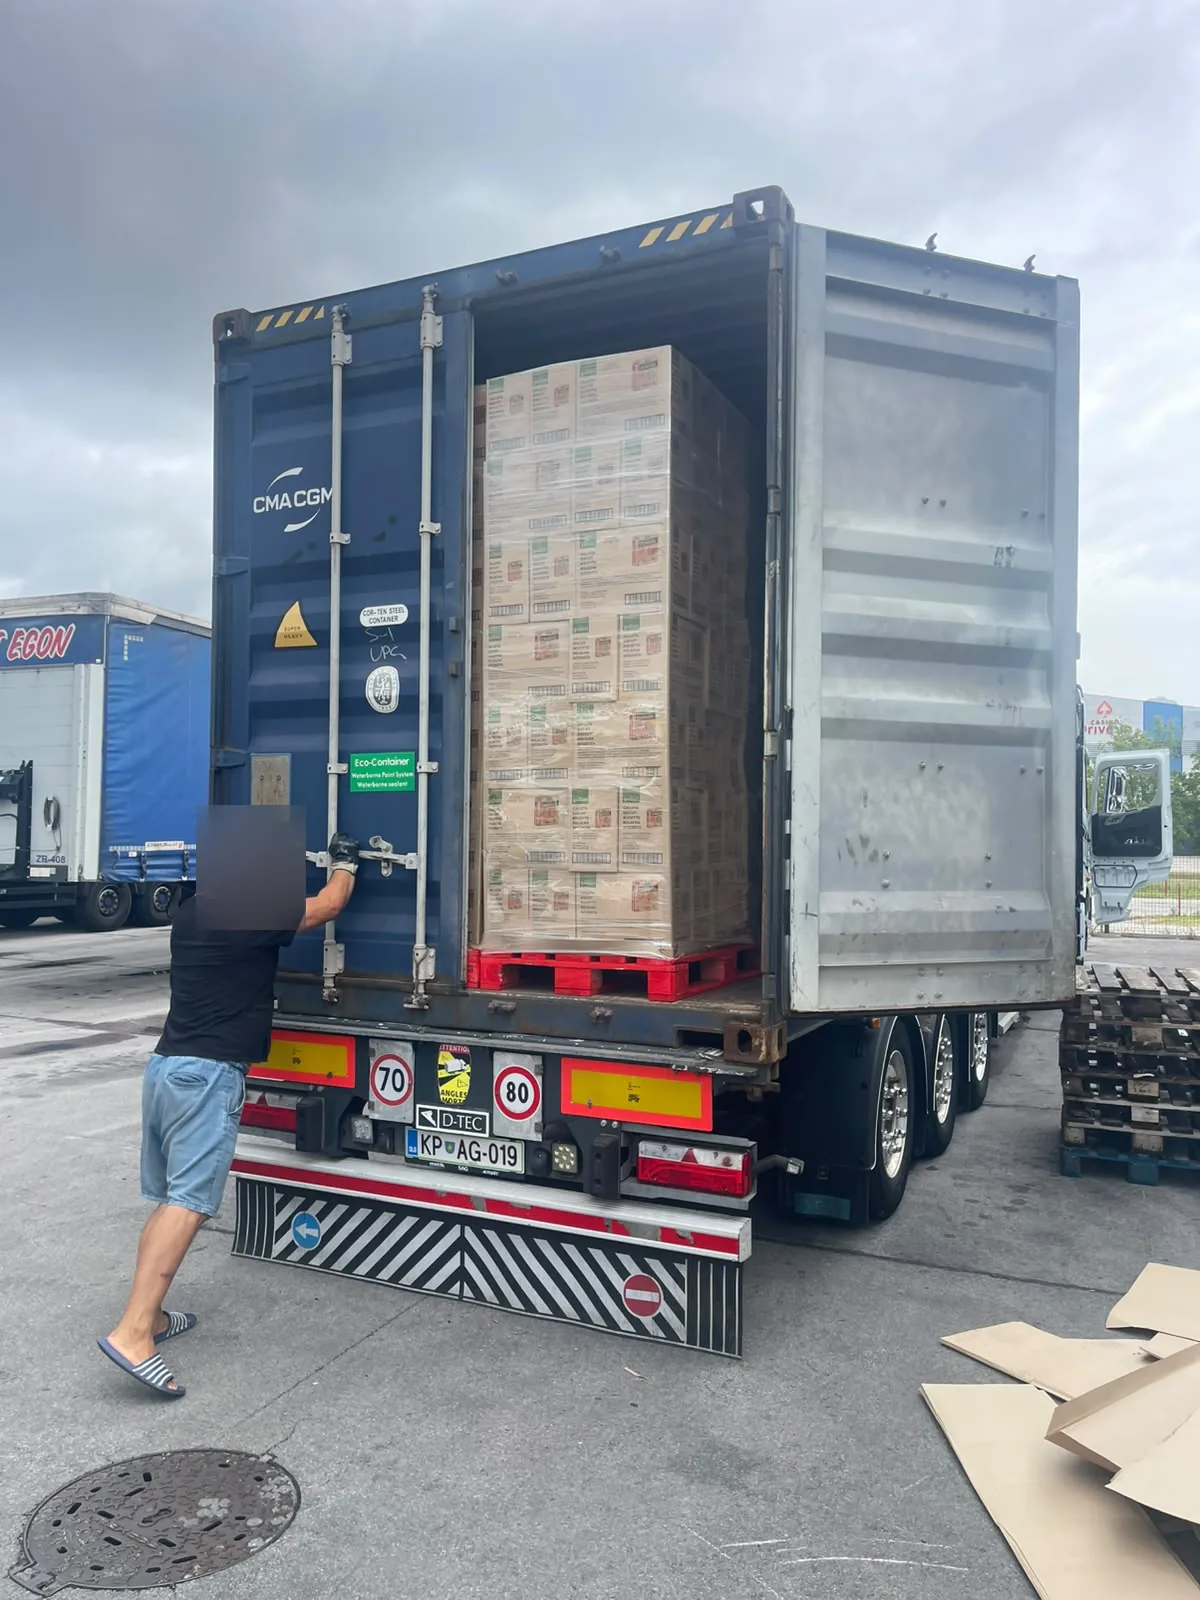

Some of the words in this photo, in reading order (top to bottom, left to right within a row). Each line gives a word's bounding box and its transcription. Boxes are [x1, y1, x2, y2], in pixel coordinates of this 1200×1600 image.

[253, 492, 292, 513] CMA
[293, 487, 332, 507] CGM
[362, 609, 388, 617] COR-TEN
[389, 606, 405, 615] STEEL
[369, 615, 399, 624] CONTAINER
[7, 623, 76, 661] EGON
[354, 756, 411, 768] Eco-Container
[351, 771, 381, 779] Waterborne
[395, 771, 414, 779] System
[356, 781, 387, 789] Waterborne
[388, 780, 408, 788] sealant
[378, 1066, 405, 1093] 70
[506, 1081, 529, 1104] 80
[442, 1112, 483, 1131] D-TEC
[420, 1133, 443, 1157] KP
[456, 1139, 518, 1167] AG-019
